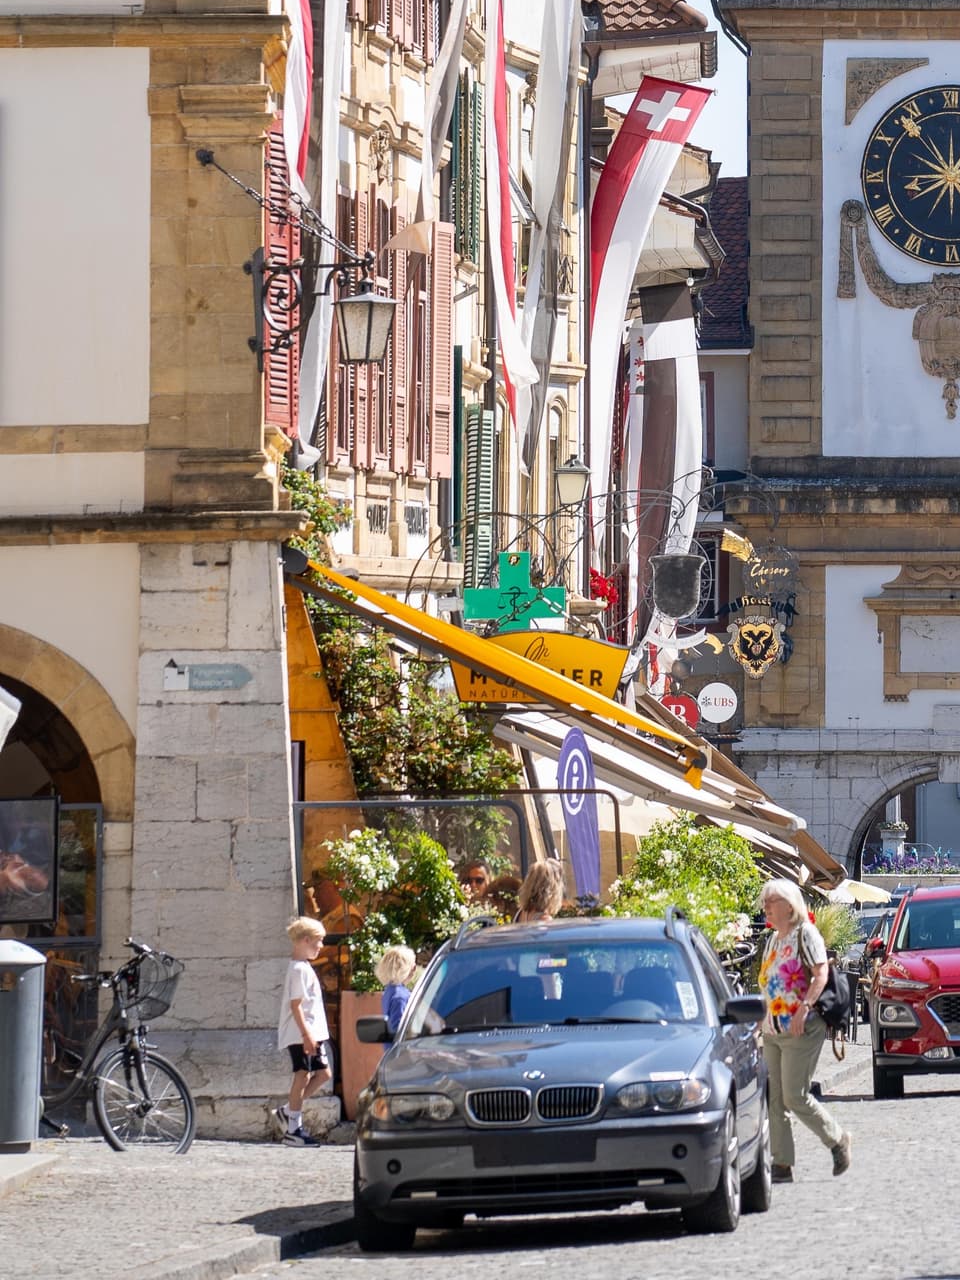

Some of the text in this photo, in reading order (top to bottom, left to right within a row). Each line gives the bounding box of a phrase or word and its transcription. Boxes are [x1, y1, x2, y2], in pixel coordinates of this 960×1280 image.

[902, 100, 922, 118] XI
[942, 91, 959, 109] XII
[874, 129, 895, 147] X
[866, 168, 884, 183] IX
[944, 244, 960, 263] VI
[713, 696, 735, 707] UBS
